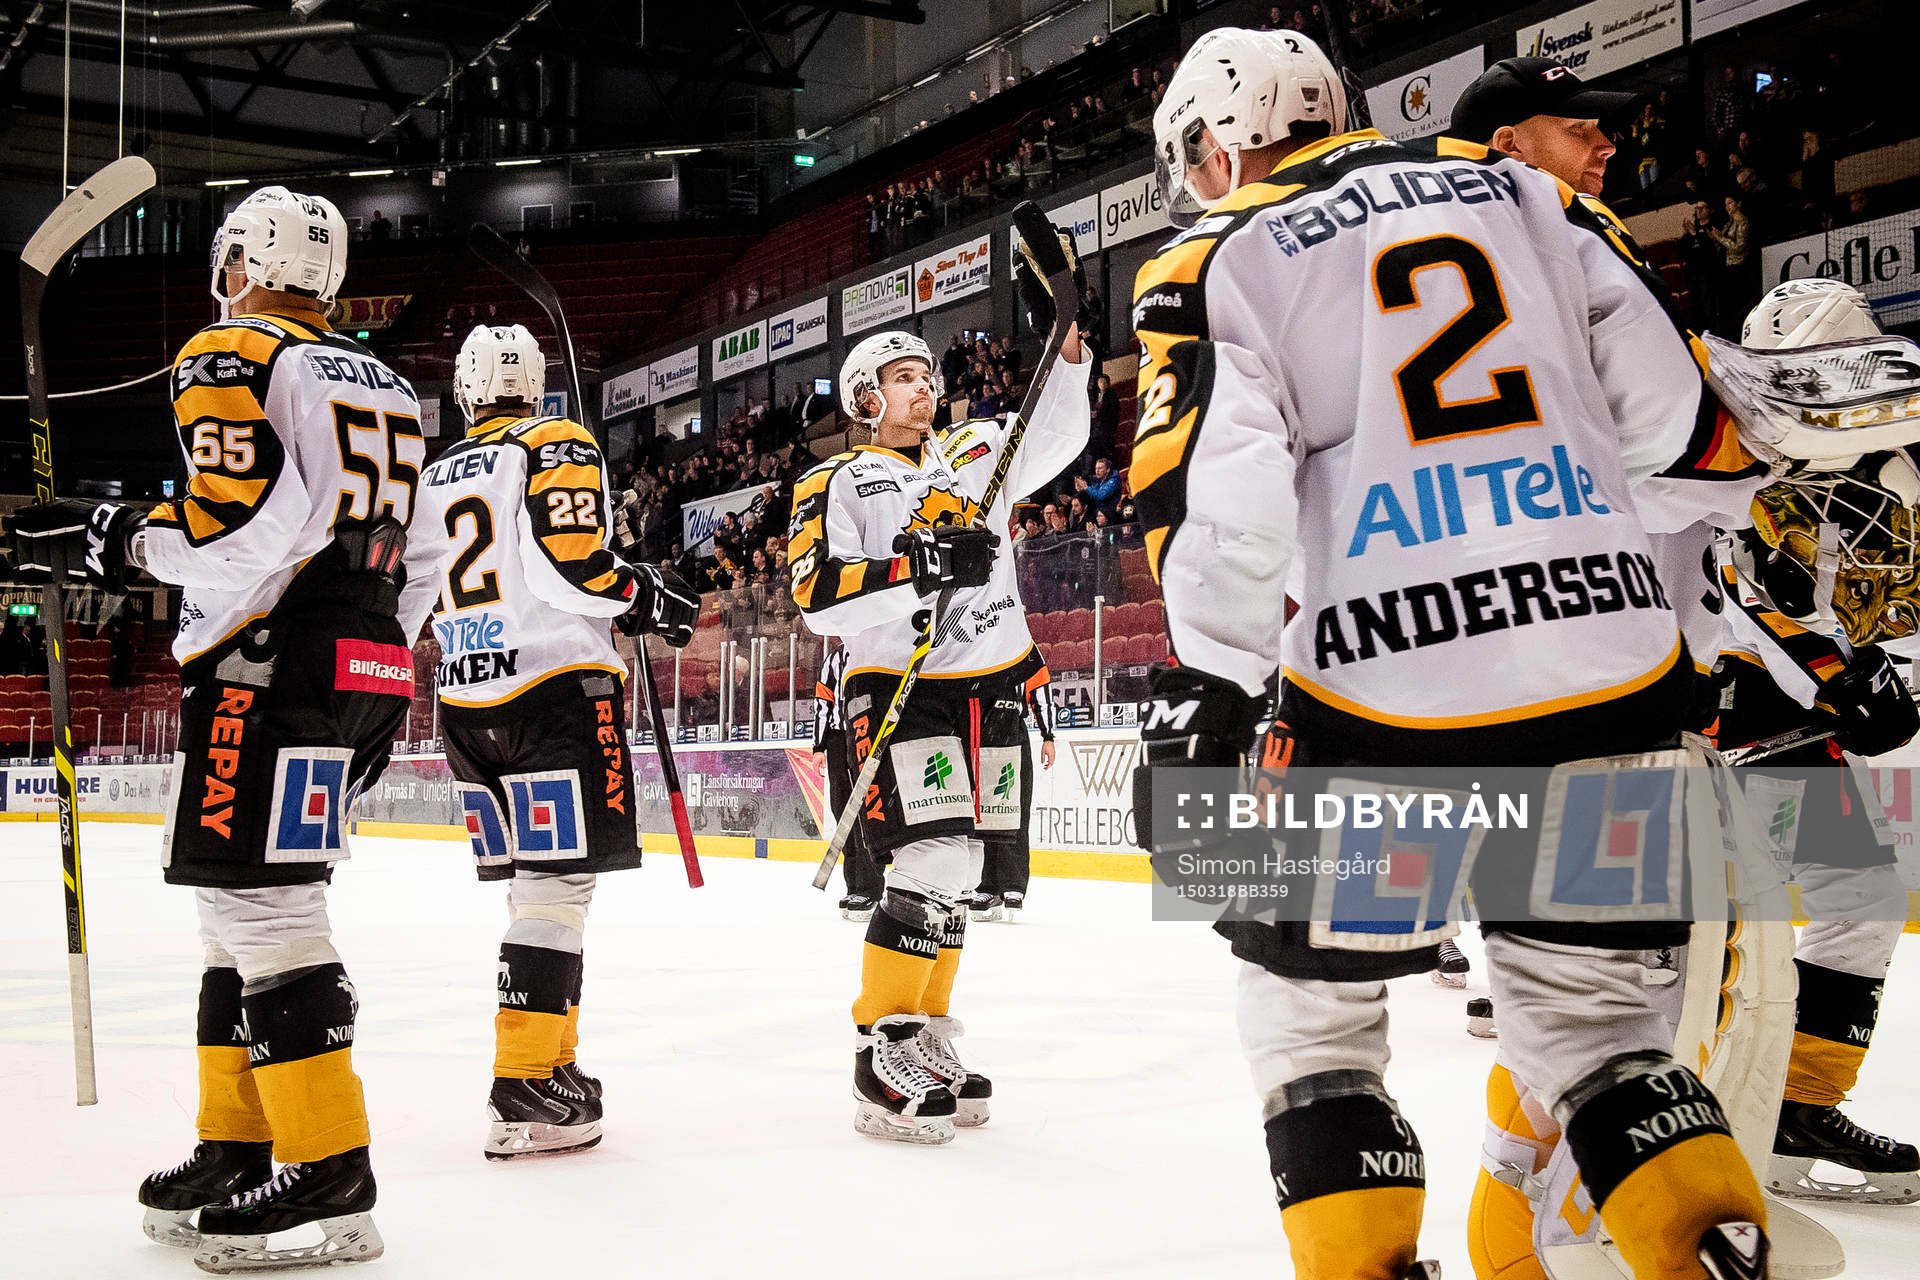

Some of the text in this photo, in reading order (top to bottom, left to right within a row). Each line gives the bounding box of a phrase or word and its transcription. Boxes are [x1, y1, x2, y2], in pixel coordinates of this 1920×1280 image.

[1285, 38, 1303, 54] 2
[1541, 21, 1594, 57] Svensk
[1169, 95, 1195, 125] CCM
[1322, 139, 1405, 167] CCM
[1106, 182, 1161, 237] gavle
[1287, 167, 1521, 251] BOLIDEN
[228, 227, 247, 236] CCM
[308, 225, 329, 245] 55
[844, 275, 894, 310] PRENOVA
[796, 314, 826, 335] SKANSKA
[718, 327, 760, 363] ABAB
[1371, 232, 1543, 448] 2
[216, 367, 237, 379] Kraft
[500, 352, 519, 365] 22
[330, 400, 424, 532] 55
[952, 445, 989, 470] skebo
[859, 481, 898, 497] ŠKODA
[1347, 445, 1610, 558] AllTele
[547, 490, 599, 528] 22
[435, 611, 504, 655] Tele
[200, 687, 255, 840] REPAY
[595, 700, 626, 816] REPAY
[15, 777, 100, 795] HUURE
[384, 782, 417, 802] Brynäs IF
[423, 777, 452, 802] unicef
[702, 772, 766, 793] Länsförsäkringar
[702, 791, 739, 811] Gävleborg
[58, 797, 74, 848] TACKS
